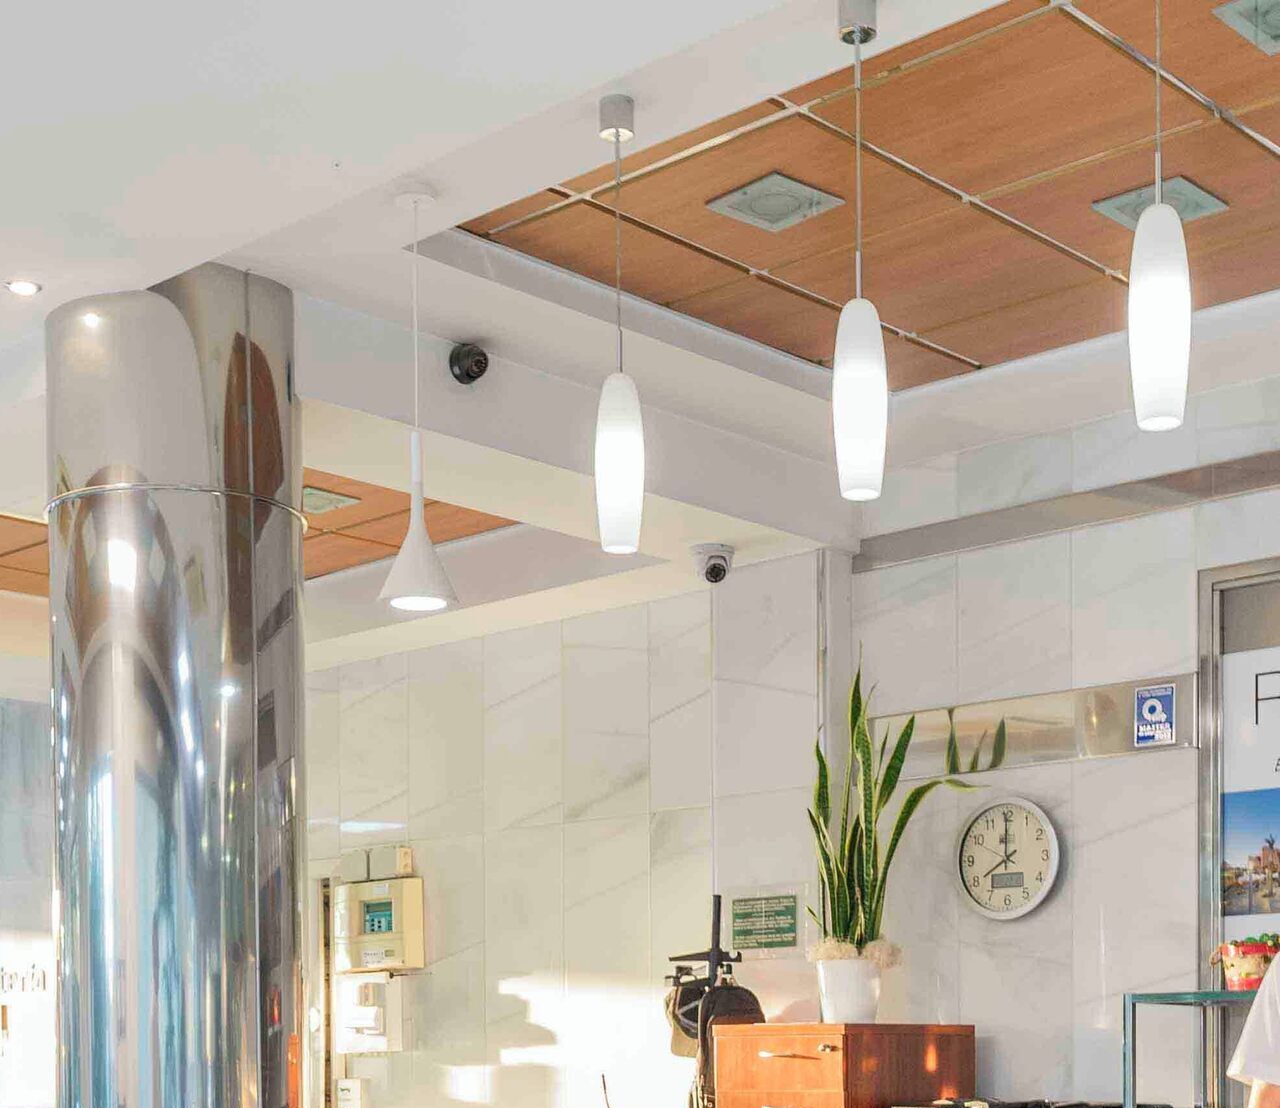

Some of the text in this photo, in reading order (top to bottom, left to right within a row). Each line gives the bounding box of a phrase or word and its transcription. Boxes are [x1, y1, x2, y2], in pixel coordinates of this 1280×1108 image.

[973, 834, 985, 847] 10
[1035, 828, 1043, 841] 2
[967, 855, 975, 867] 9
[1041, 849, 1049, 861] 3
[972, 875, 980, 888] 8
[1035, 871, 1043, 883] 4
[1022, 887, 1030, 900] 5
[1003, 894, 1012, 906] 6
